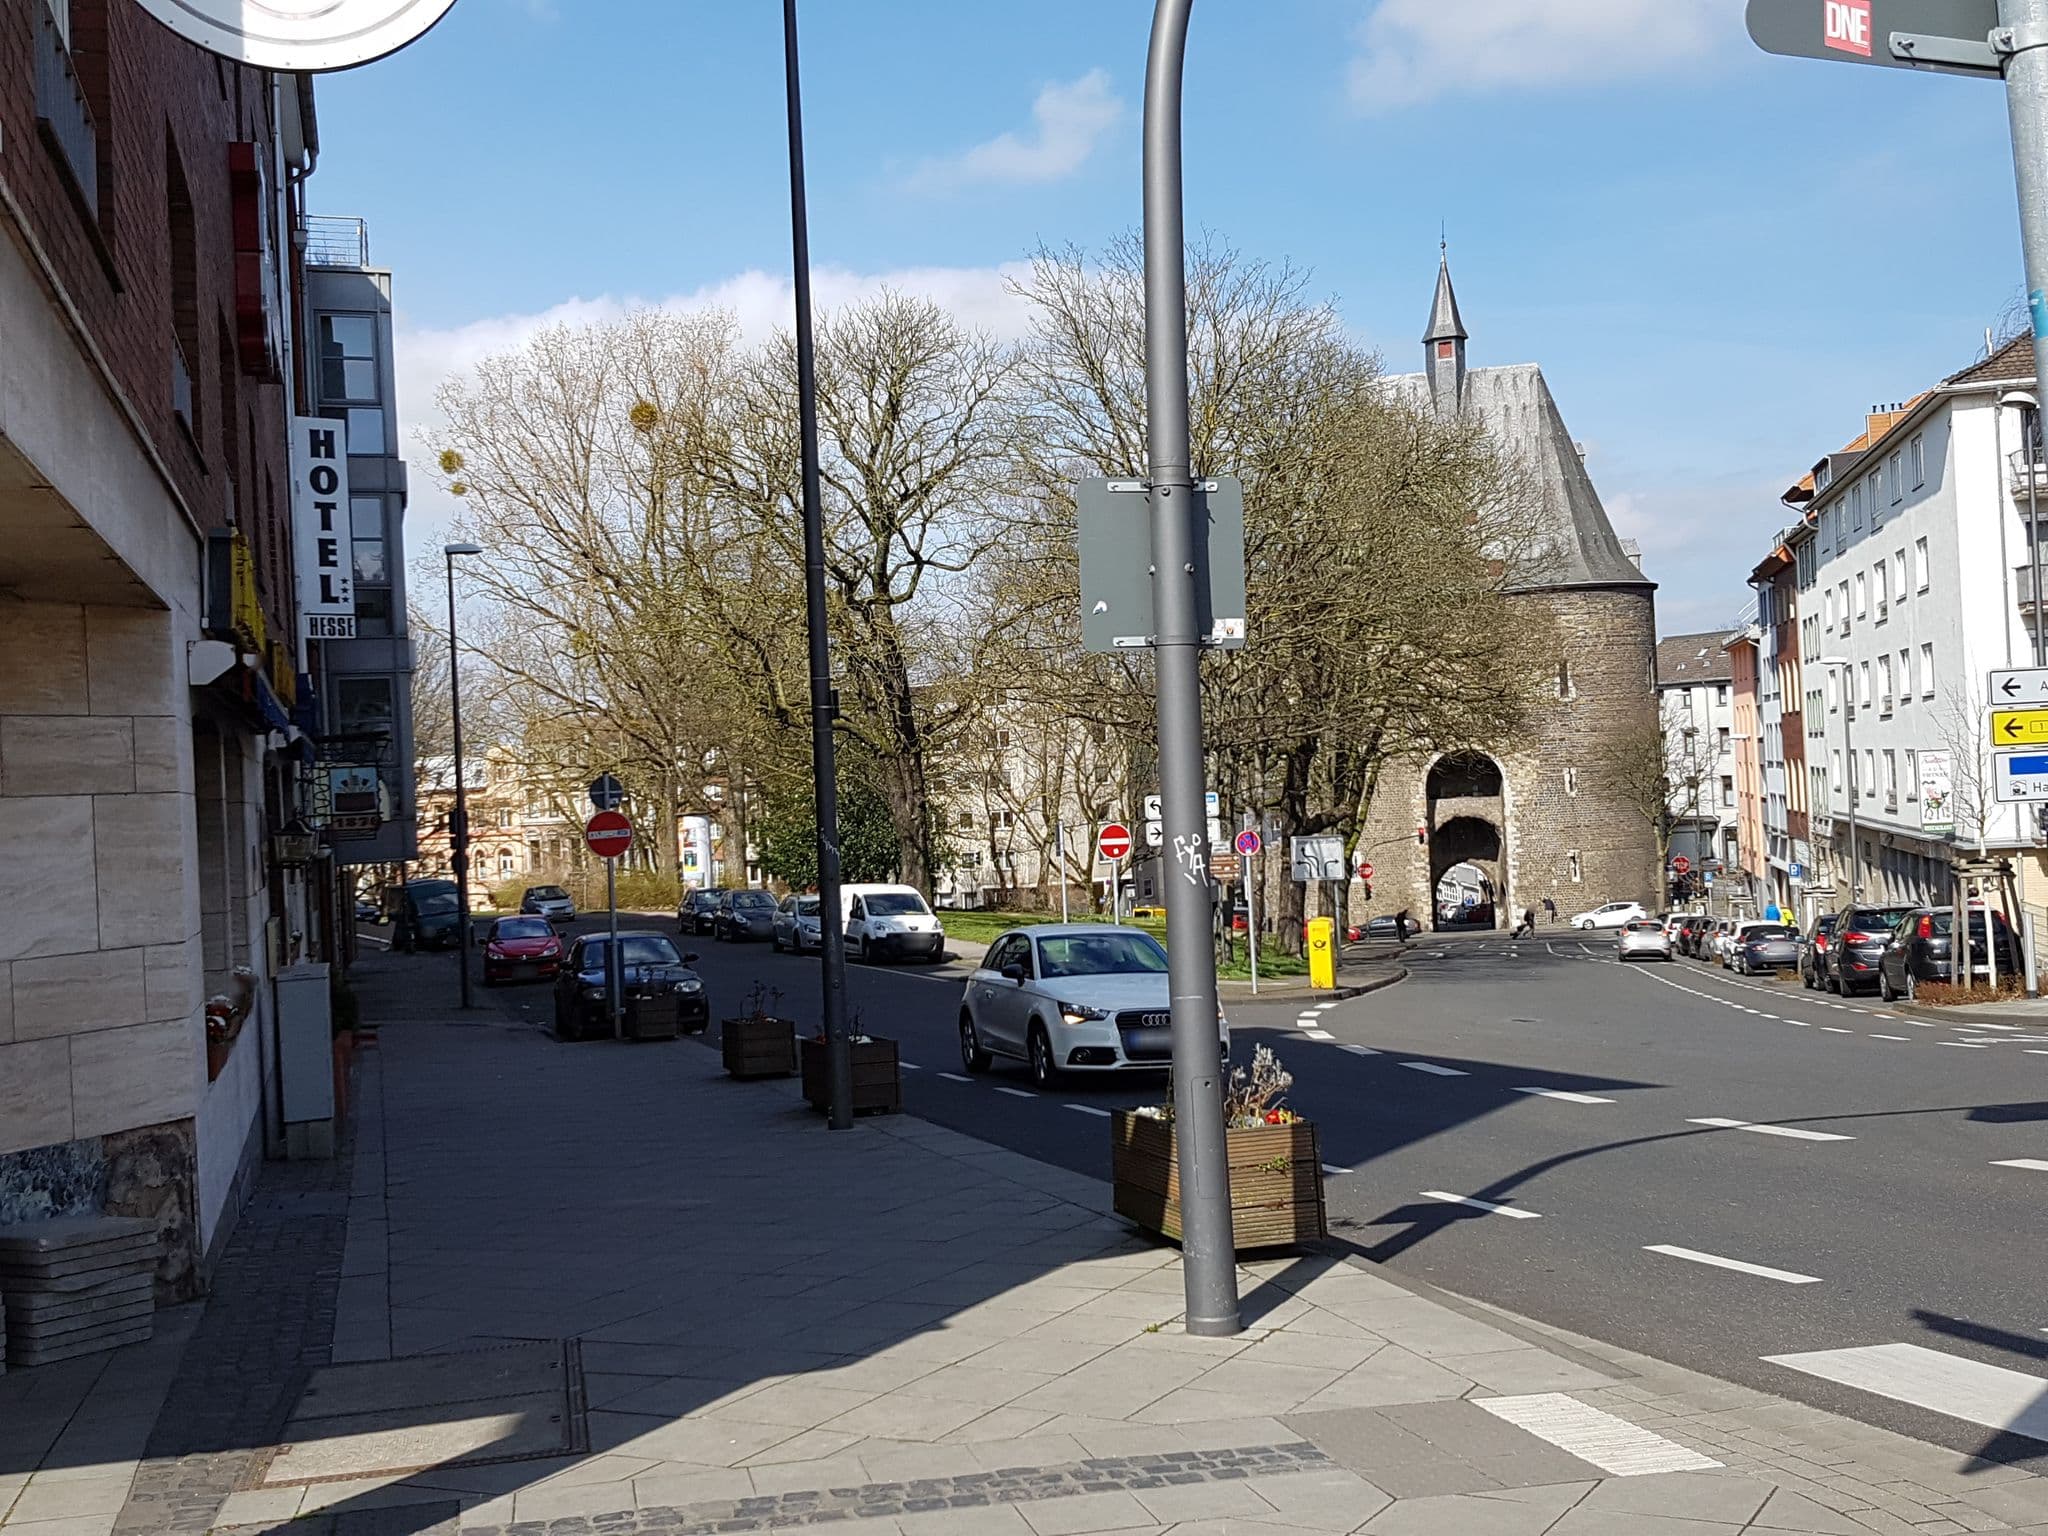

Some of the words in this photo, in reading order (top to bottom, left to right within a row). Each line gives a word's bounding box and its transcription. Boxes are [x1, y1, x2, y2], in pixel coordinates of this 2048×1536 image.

[1826, 1, 1869, 46] DNE
[309, 428, 340, 604] HOTEL
[309, 617, 353, 637] HESSE
